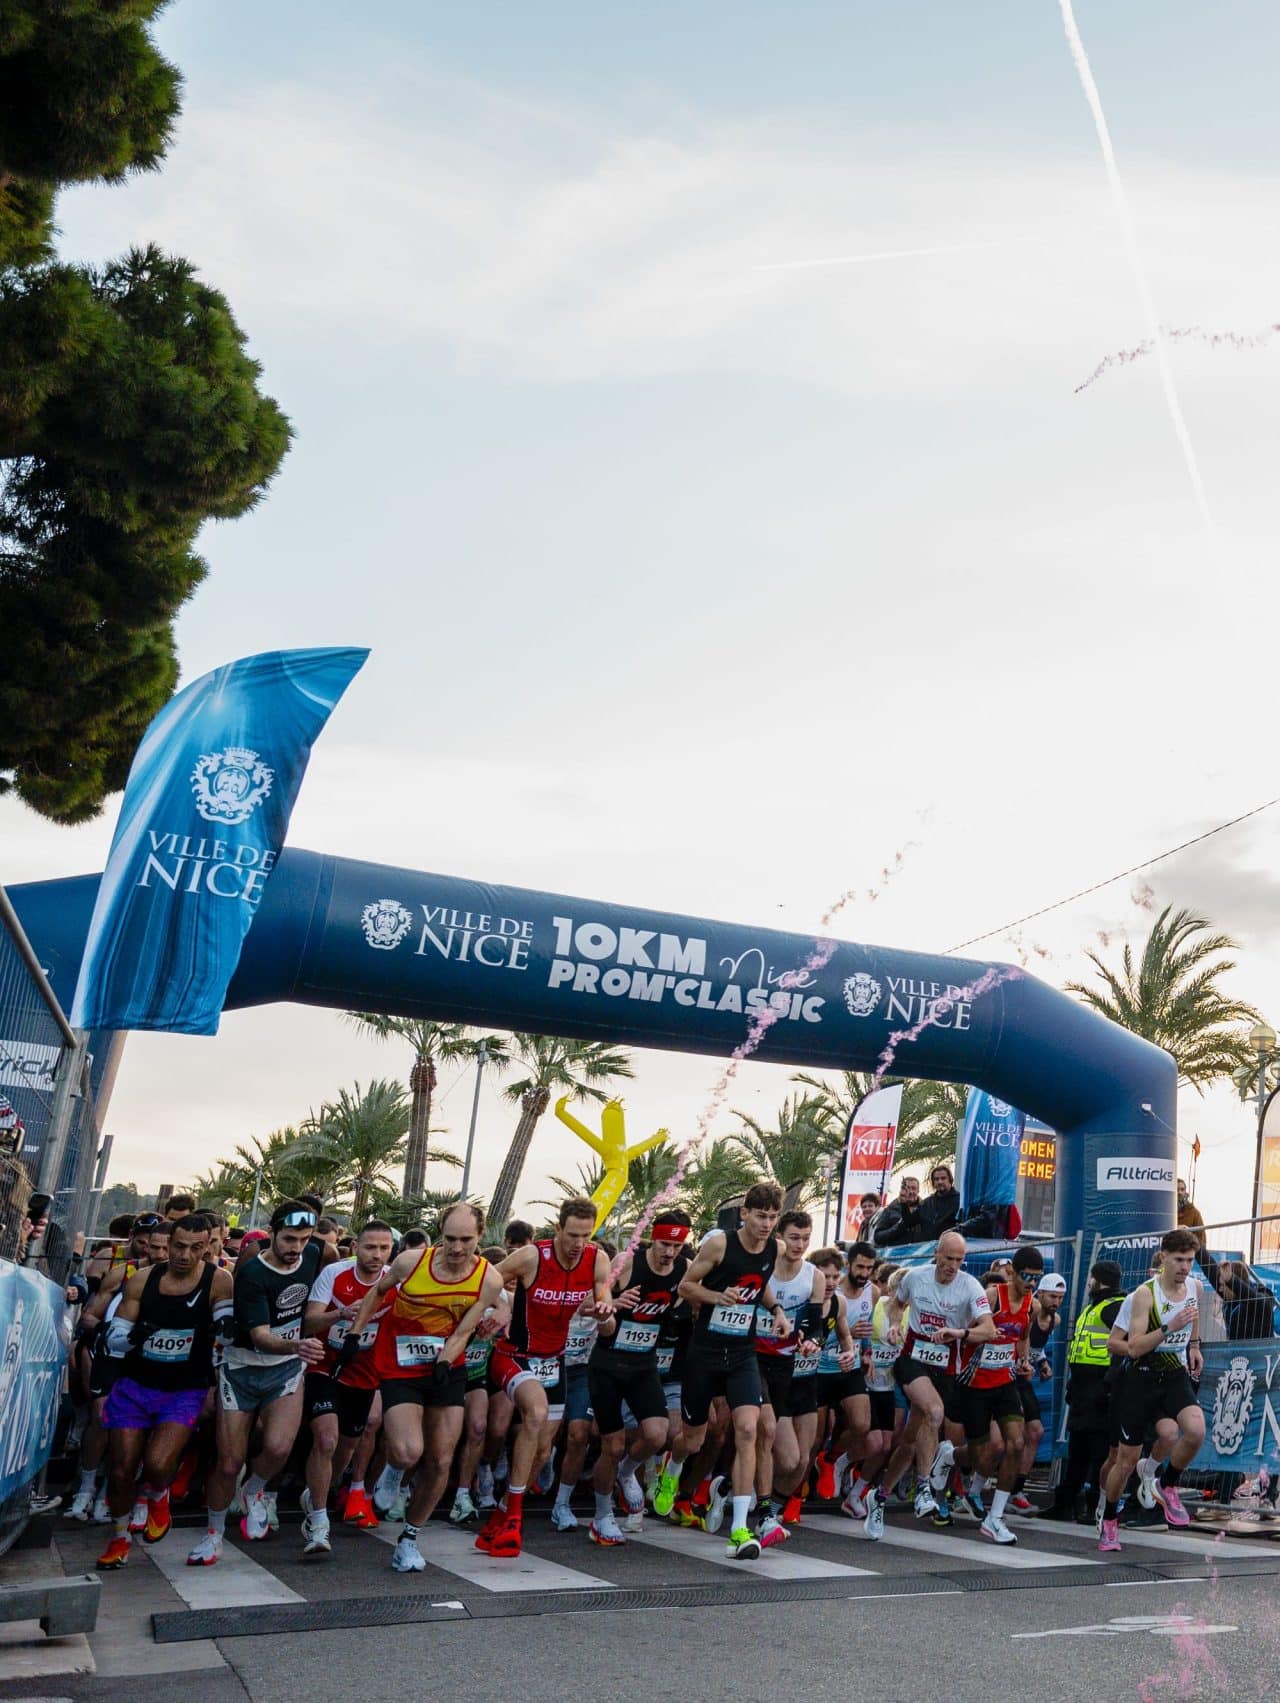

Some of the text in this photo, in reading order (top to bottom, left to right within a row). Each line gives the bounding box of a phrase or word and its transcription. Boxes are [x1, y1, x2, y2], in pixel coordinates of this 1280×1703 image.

[148, 830, 276, 871] VILLE DE
[136, 853, 269, 904] NICE
[420, 904, 534, 939] VILLE DE
[414, 923, 532, 970] NICE
[553, 916, 707, 975] 10KM
[719, 948, 818, 990] Nice
[547, 959, 826, 1023] PROM'CLASSIC
[886, 976, 973, 1002] VILLE DE
[883, 993, 972, 1030] NICE
[975, 1122, 1005, 1133] VILLE
[974, 1131, 1022, 1147] NICE
[1106, 1167, 1174, 1181] Alltricks
[277, 1306, 302, 1319] NIKE
[720, 1310, 747, 1324] 1178
[149, 1336, 186, 1350] 1409
[625, 1331, 651, 1342] 1193
[406, 1343, 435, 1355] 1101
[919, 1349, 944, 1361] 1166
[985, 1350, 1010, 1361] 2300
